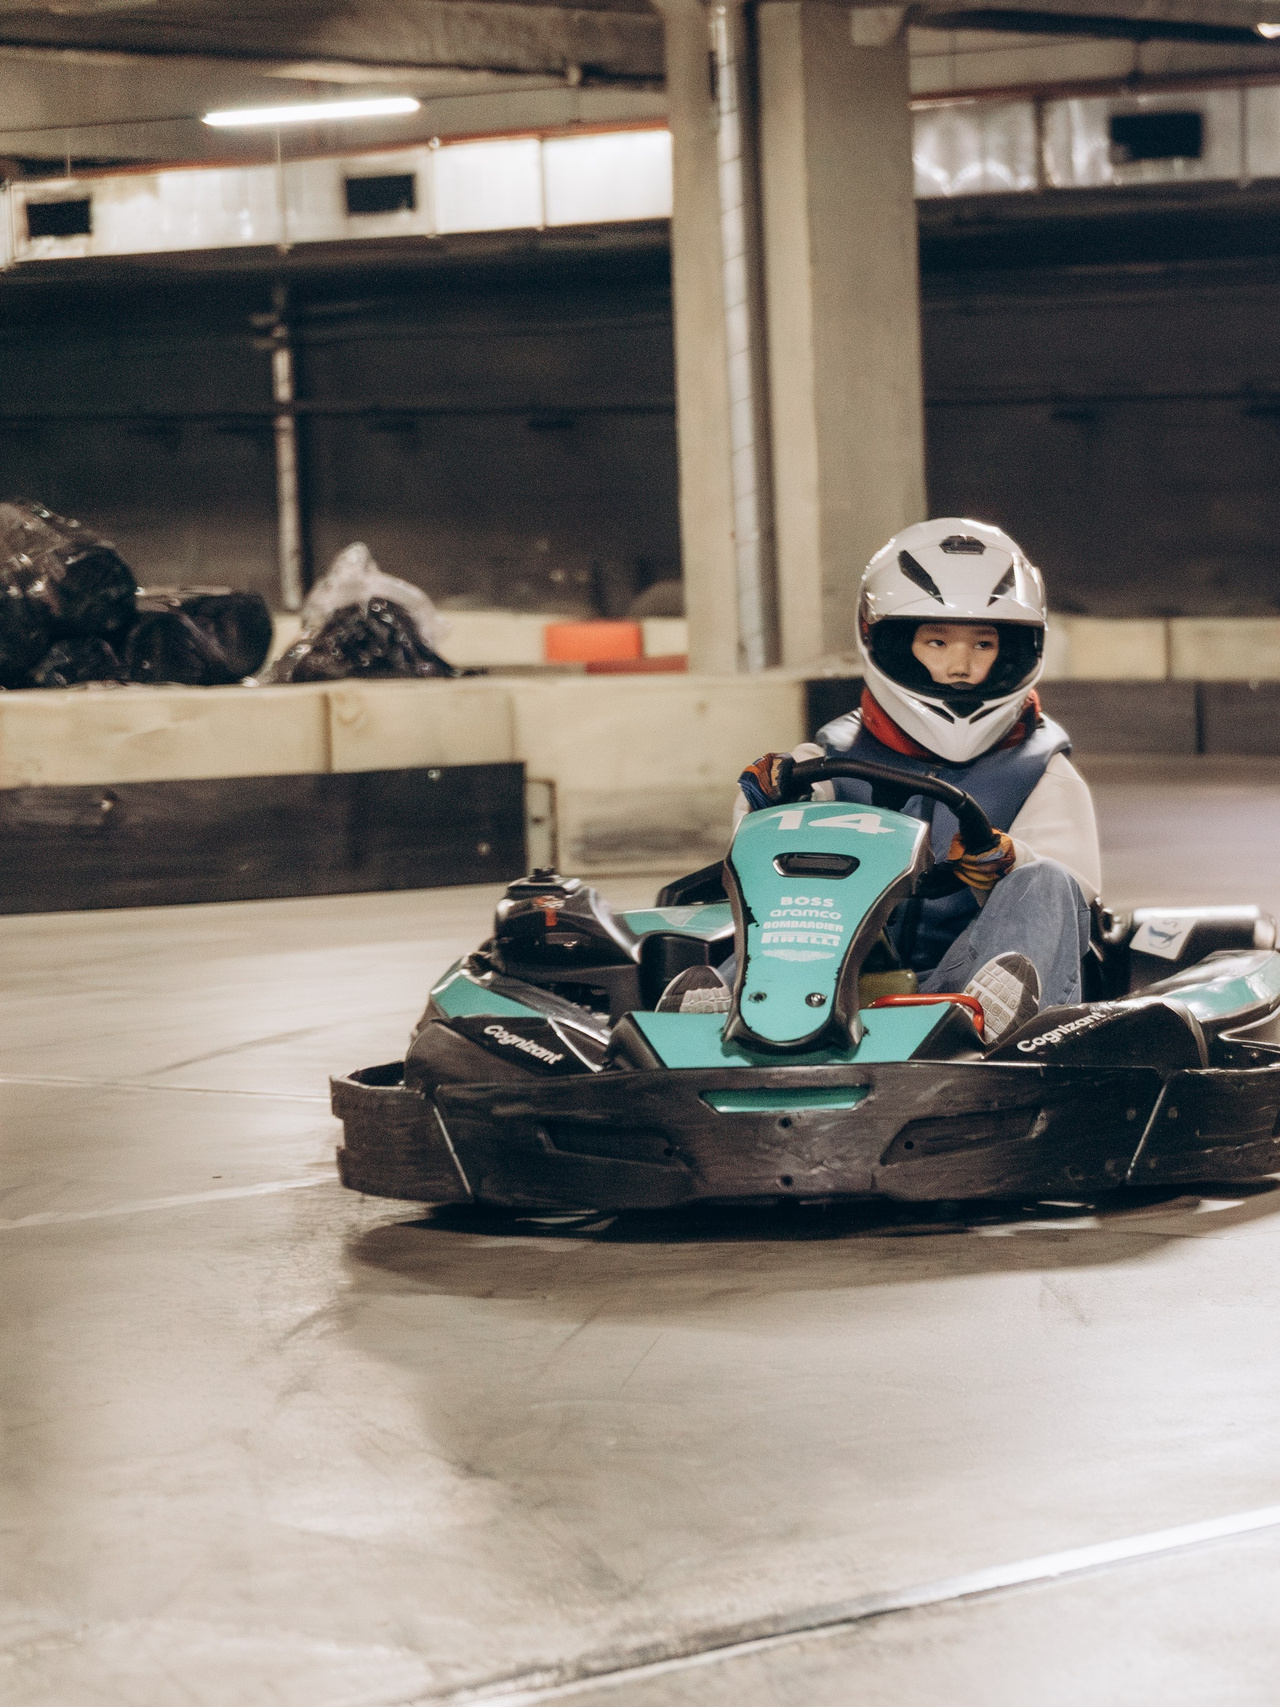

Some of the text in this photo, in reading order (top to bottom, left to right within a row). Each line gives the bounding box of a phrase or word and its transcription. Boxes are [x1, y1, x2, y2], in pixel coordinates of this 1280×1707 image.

[769, 810, 896, 835] 14
[779, 897, 834, 908] BOSS
[769, 909, 842, 920] aramco
[763, 921, 843, 932] BOMBARDIER
[1016, 1012, 1107, 1053] Cognizant
[483, 1024, 564, 1065] Cognizant
